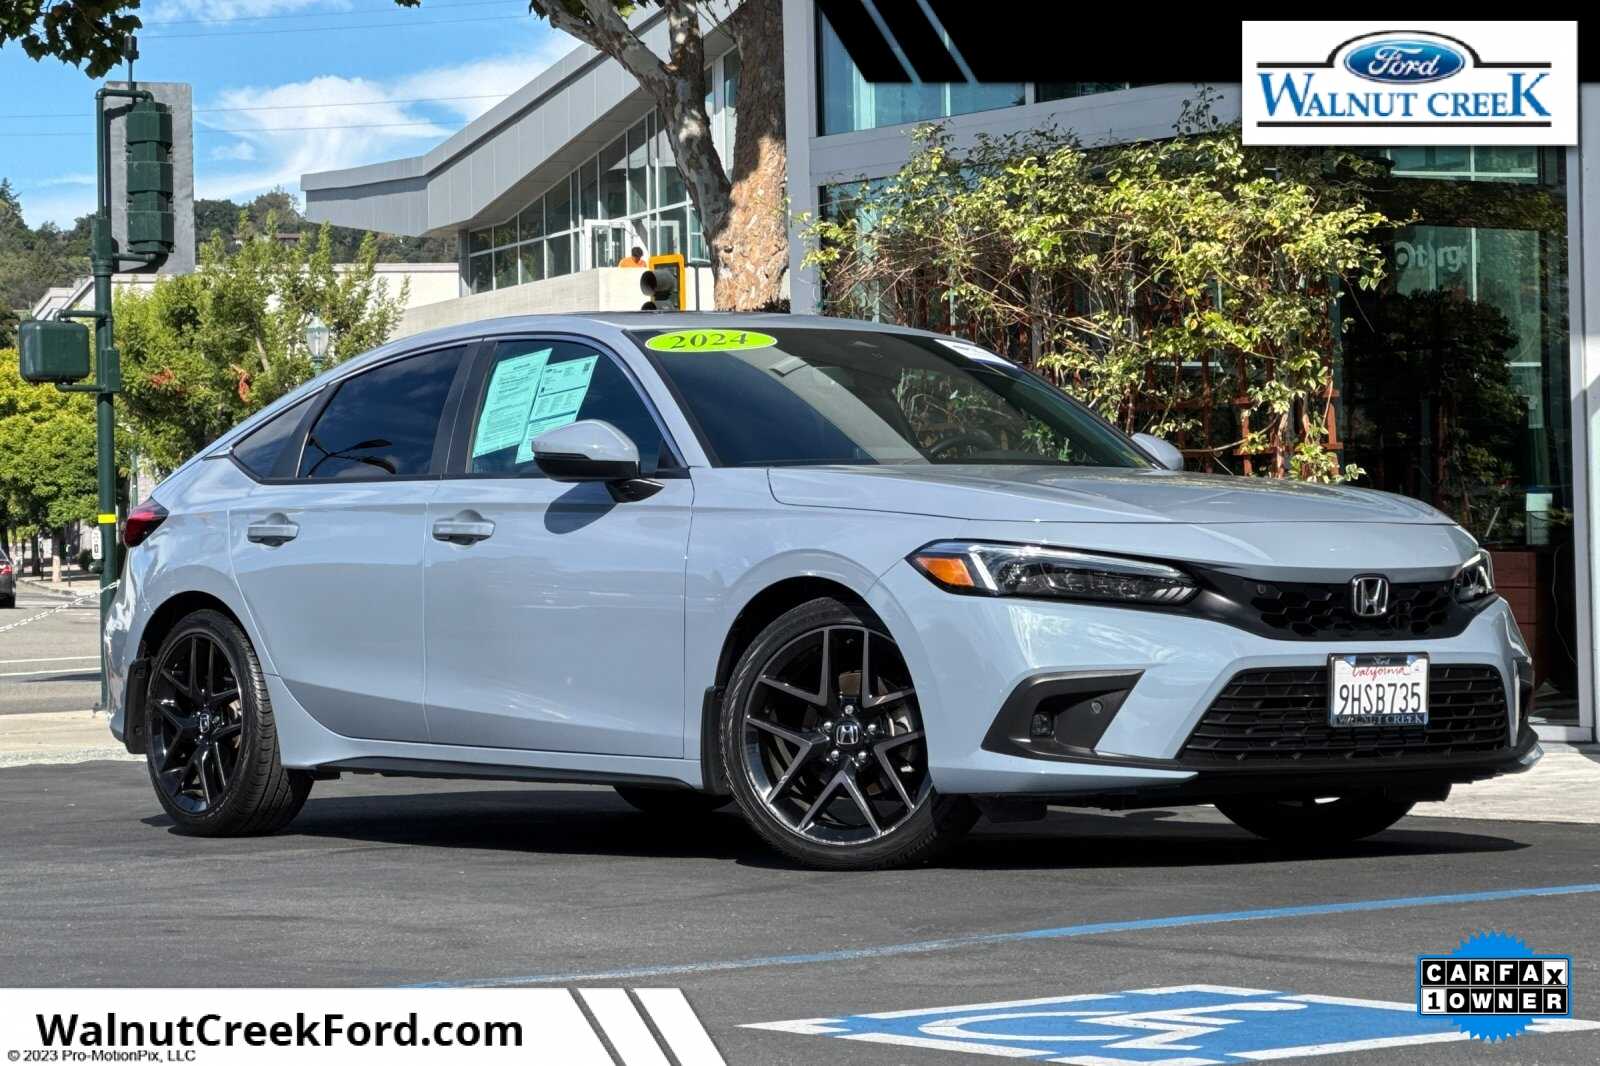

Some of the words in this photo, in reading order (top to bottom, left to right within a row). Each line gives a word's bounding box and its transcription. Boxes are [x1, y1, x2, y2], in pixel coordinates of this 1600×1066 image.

[669, 332, 748, 349] 2024
[1352, 666, 1410, 681] California
[1339, 682, 1421, 715] 9HSB735
